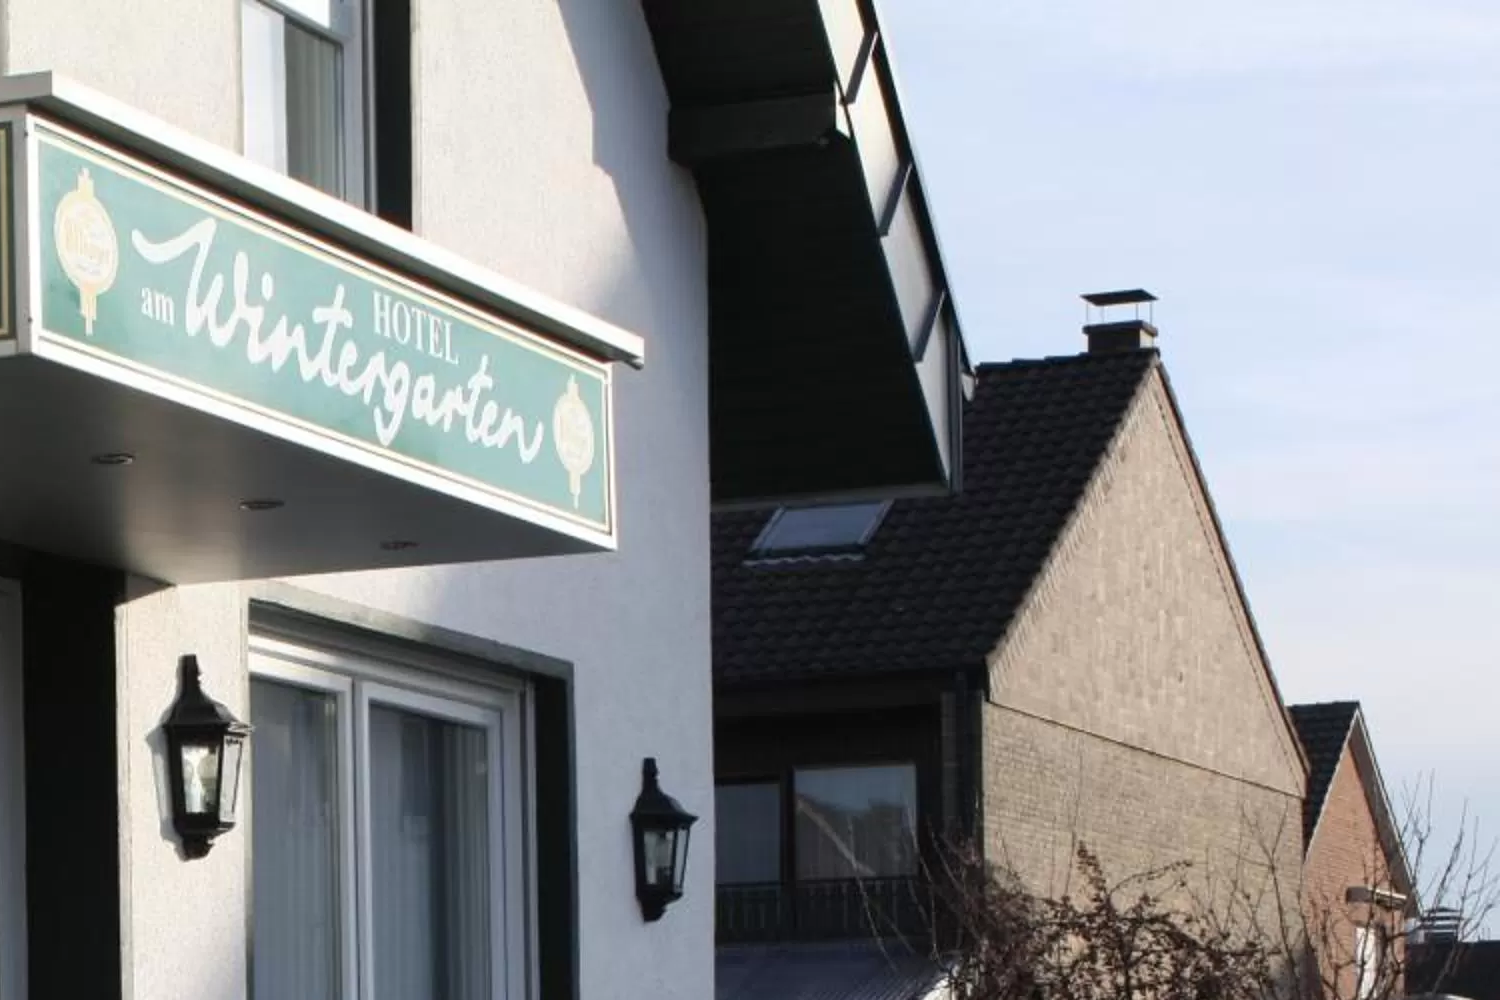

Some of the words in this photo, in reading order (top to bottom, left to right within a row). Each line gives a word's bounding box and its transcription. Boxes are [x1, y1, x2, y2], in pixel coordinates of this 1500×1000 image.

[131, 217, 544, 463] Wintergarten
[141, 283, 175, 325] am
[373, 291, 458, 365] HOTEL
